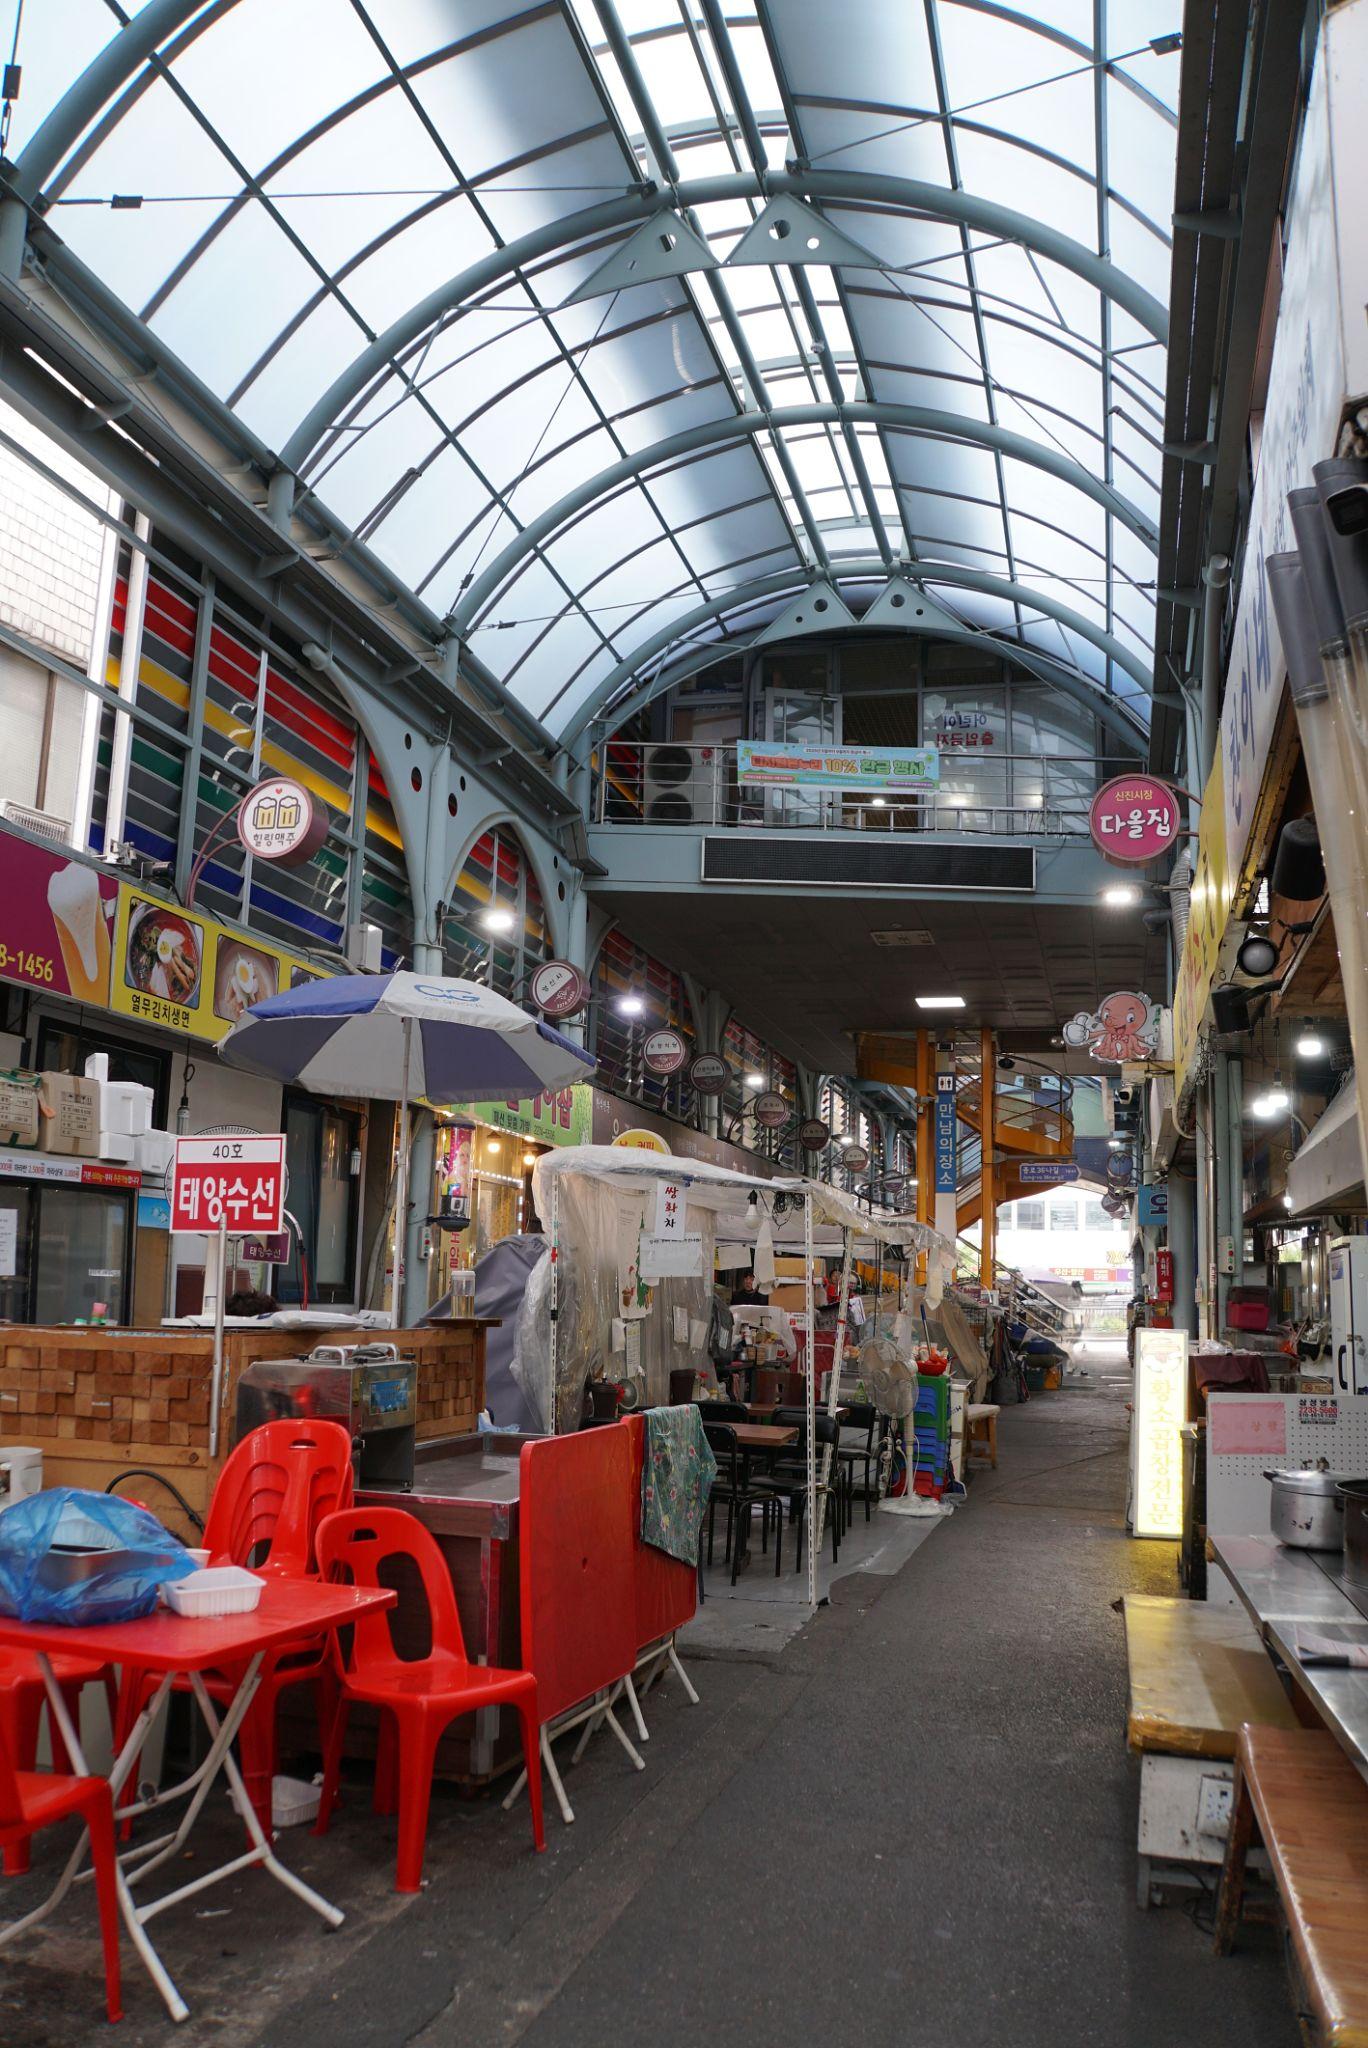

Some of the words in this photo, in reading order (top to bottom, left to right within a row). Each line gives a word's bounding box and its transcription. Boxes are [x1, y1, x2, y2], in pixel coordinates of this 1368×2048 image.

[825, 758, 858, 773] 10%
[893, 759, 925, 776] 행사
[1114, 789, 1153, 801] 신진시장
[1100, 807, 1171, 839] 다올집
[253, 832, 296, 847] 힐링맥주
[131, 994, 190, 1028] 열무김치생면
[212, 1143, 243, 1159] 40호
[938, 1103, 954, 1185] 만남의장소
[179, 1176, 275, 1223] 태양수선
[665, 1186, 679, 1228] 쌍화차
[249, 1246, 281, 1259] 태양수선
[1148, 1379, 1174, 1526] 황소곱창전문
